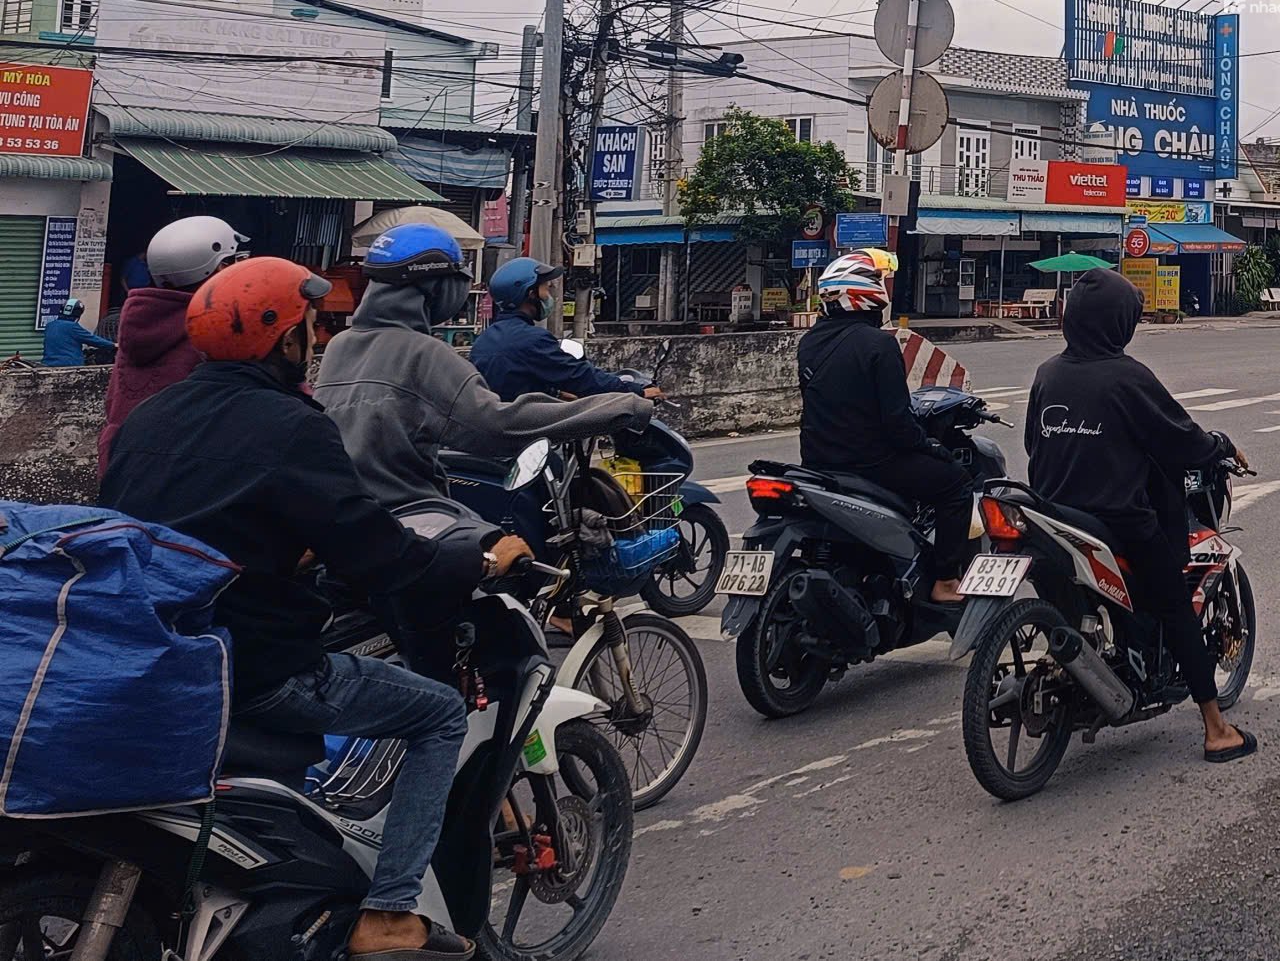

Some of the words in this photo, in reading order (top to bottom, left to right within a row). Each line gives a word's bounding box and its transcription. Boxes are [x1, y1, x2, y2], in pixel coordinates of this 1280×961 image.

[3, 70, 24, 84] MỸ
[26, 72, 51, 86] HÒA
[13, 91, 41, 107] CÔNG
[1111, 96, 1139, 119] NHÀ
[1144, 98, 1186, 123] THUỐC
[0, 113, 26, 130] TỤNG
[28, 115, 43, 131] TẠI
[46, 114, 63, 130] TÒA
[65, 116, 80, 131] ÁN
[7, 138, 22, 148] 53
[25, 139, 41, 149] 53
[43, 140, 59, 150] 36
[596, 128, 637, 152] KHÁCH
[1154, 125, 1215, 162] CHÂU
[602, 154, 627, 178] SẠN
[1012, 174, 1027, 182] THU
[1027, 173, 1045, 183] THẢO
[1069, 173, 1109, 187] viettel
[1083, 189, 1107, 197] telecom
[1130, 238, 1144, 248] 5G
[731, 555, 767, 573] 71-AB
[977, 559, 1021, 575] 83-Y1
[721, 574, 765, 592] 076.22
[965, 575, 1017, 594] 129.91
[1098, 578, 1110, 592] One
[1107, 584, 1126, 601] HEART
